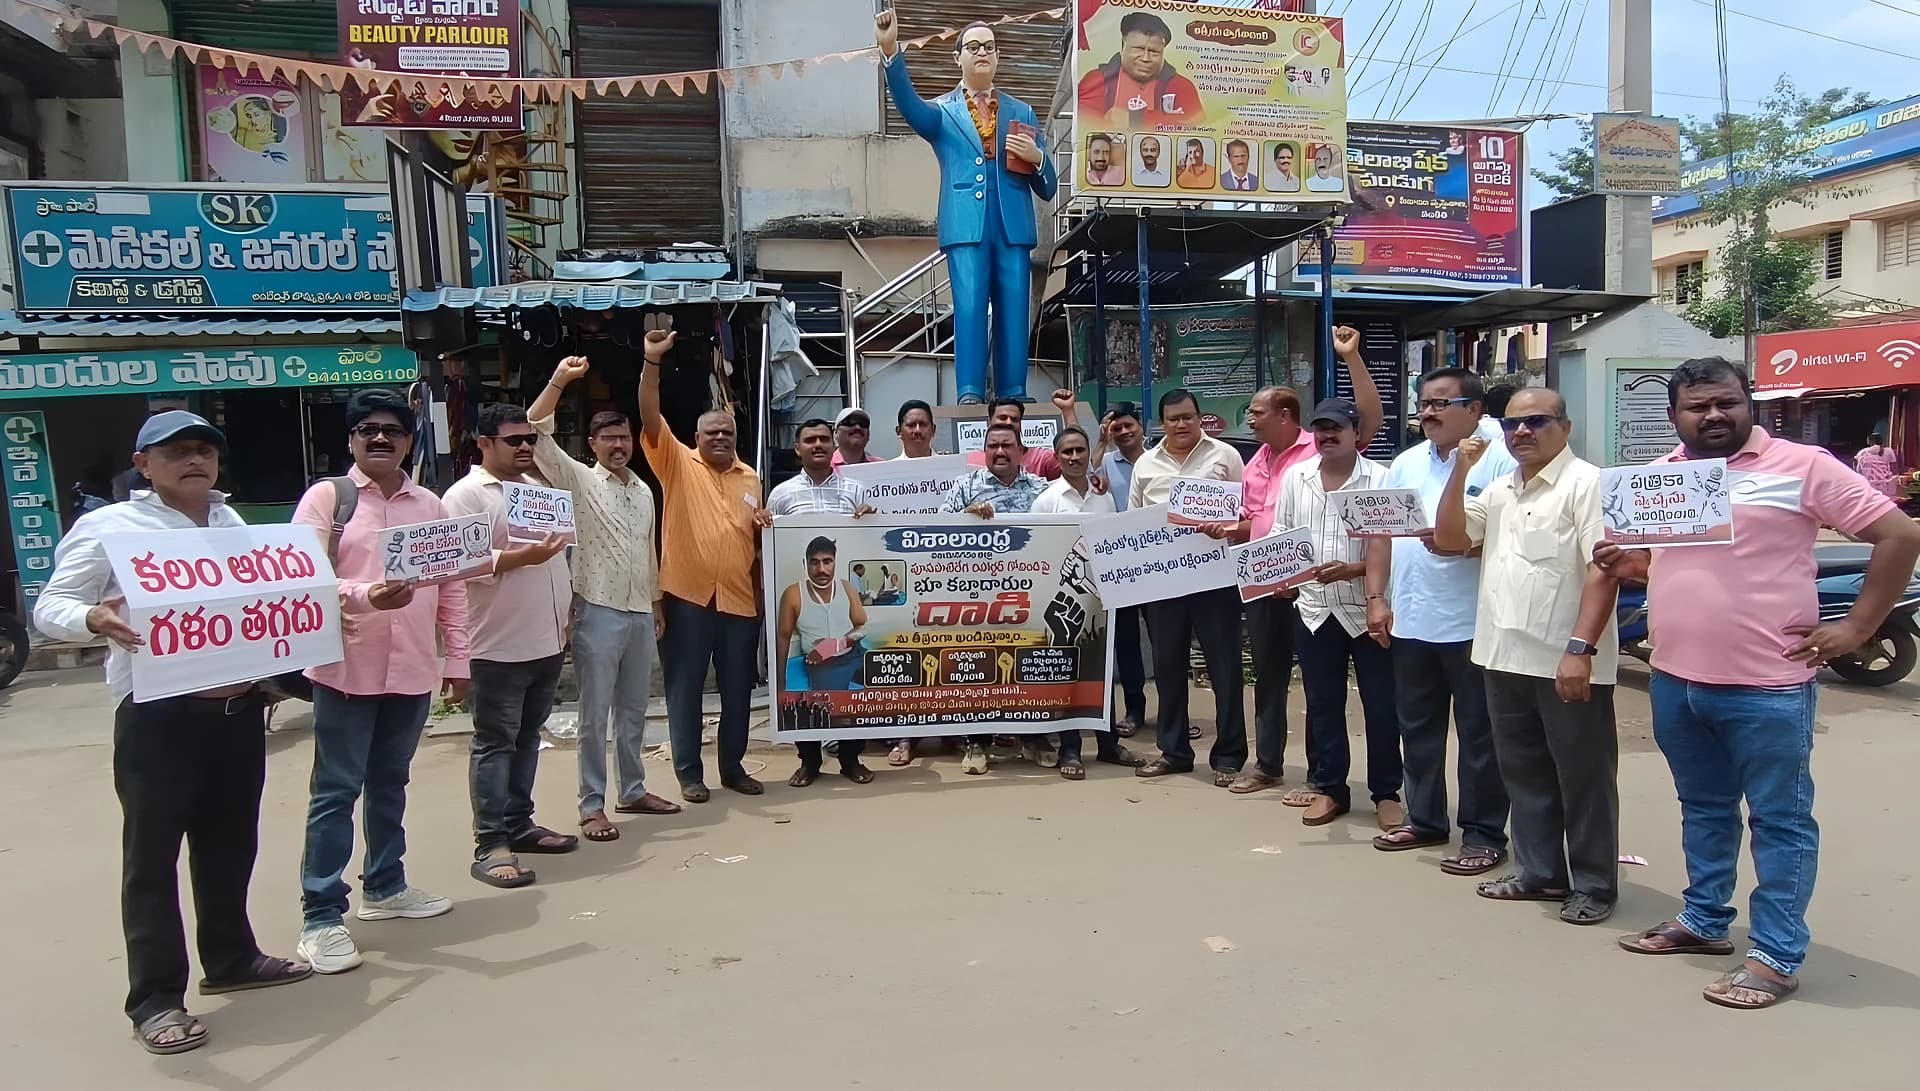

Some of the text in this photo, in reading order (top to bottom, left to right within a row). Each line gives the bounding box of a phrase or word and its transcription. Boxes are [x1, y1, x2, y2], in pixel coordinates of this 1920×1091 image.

[350, 25, 509, 45] BEAUTY PARLOUR
[1478, 136, 1504, 159] 10
[211, 194, 268, 225] SK
[65, 226, 202, 270] మెడికల్
[208, 243, 236, 269] &
[241, 228, 357, 271] జనరల్
[134, 284, 148, 297] &
[170, 351, 276, 386] షాపు
[1802, 354, 1832, 366] airtel
[1630, 474, 1684, 491] పత్రికా
[901, 528, 1011, 553] విశాలాంధ్ర
[130, 543, 316, 593] కలం ఆగదు
[914, 575, 1033, 599] భూ కబ్జాదారుల
[917, 592, 1031, 627] దాడి
[150, 593, 324, 658] గళం తగ్గదు
